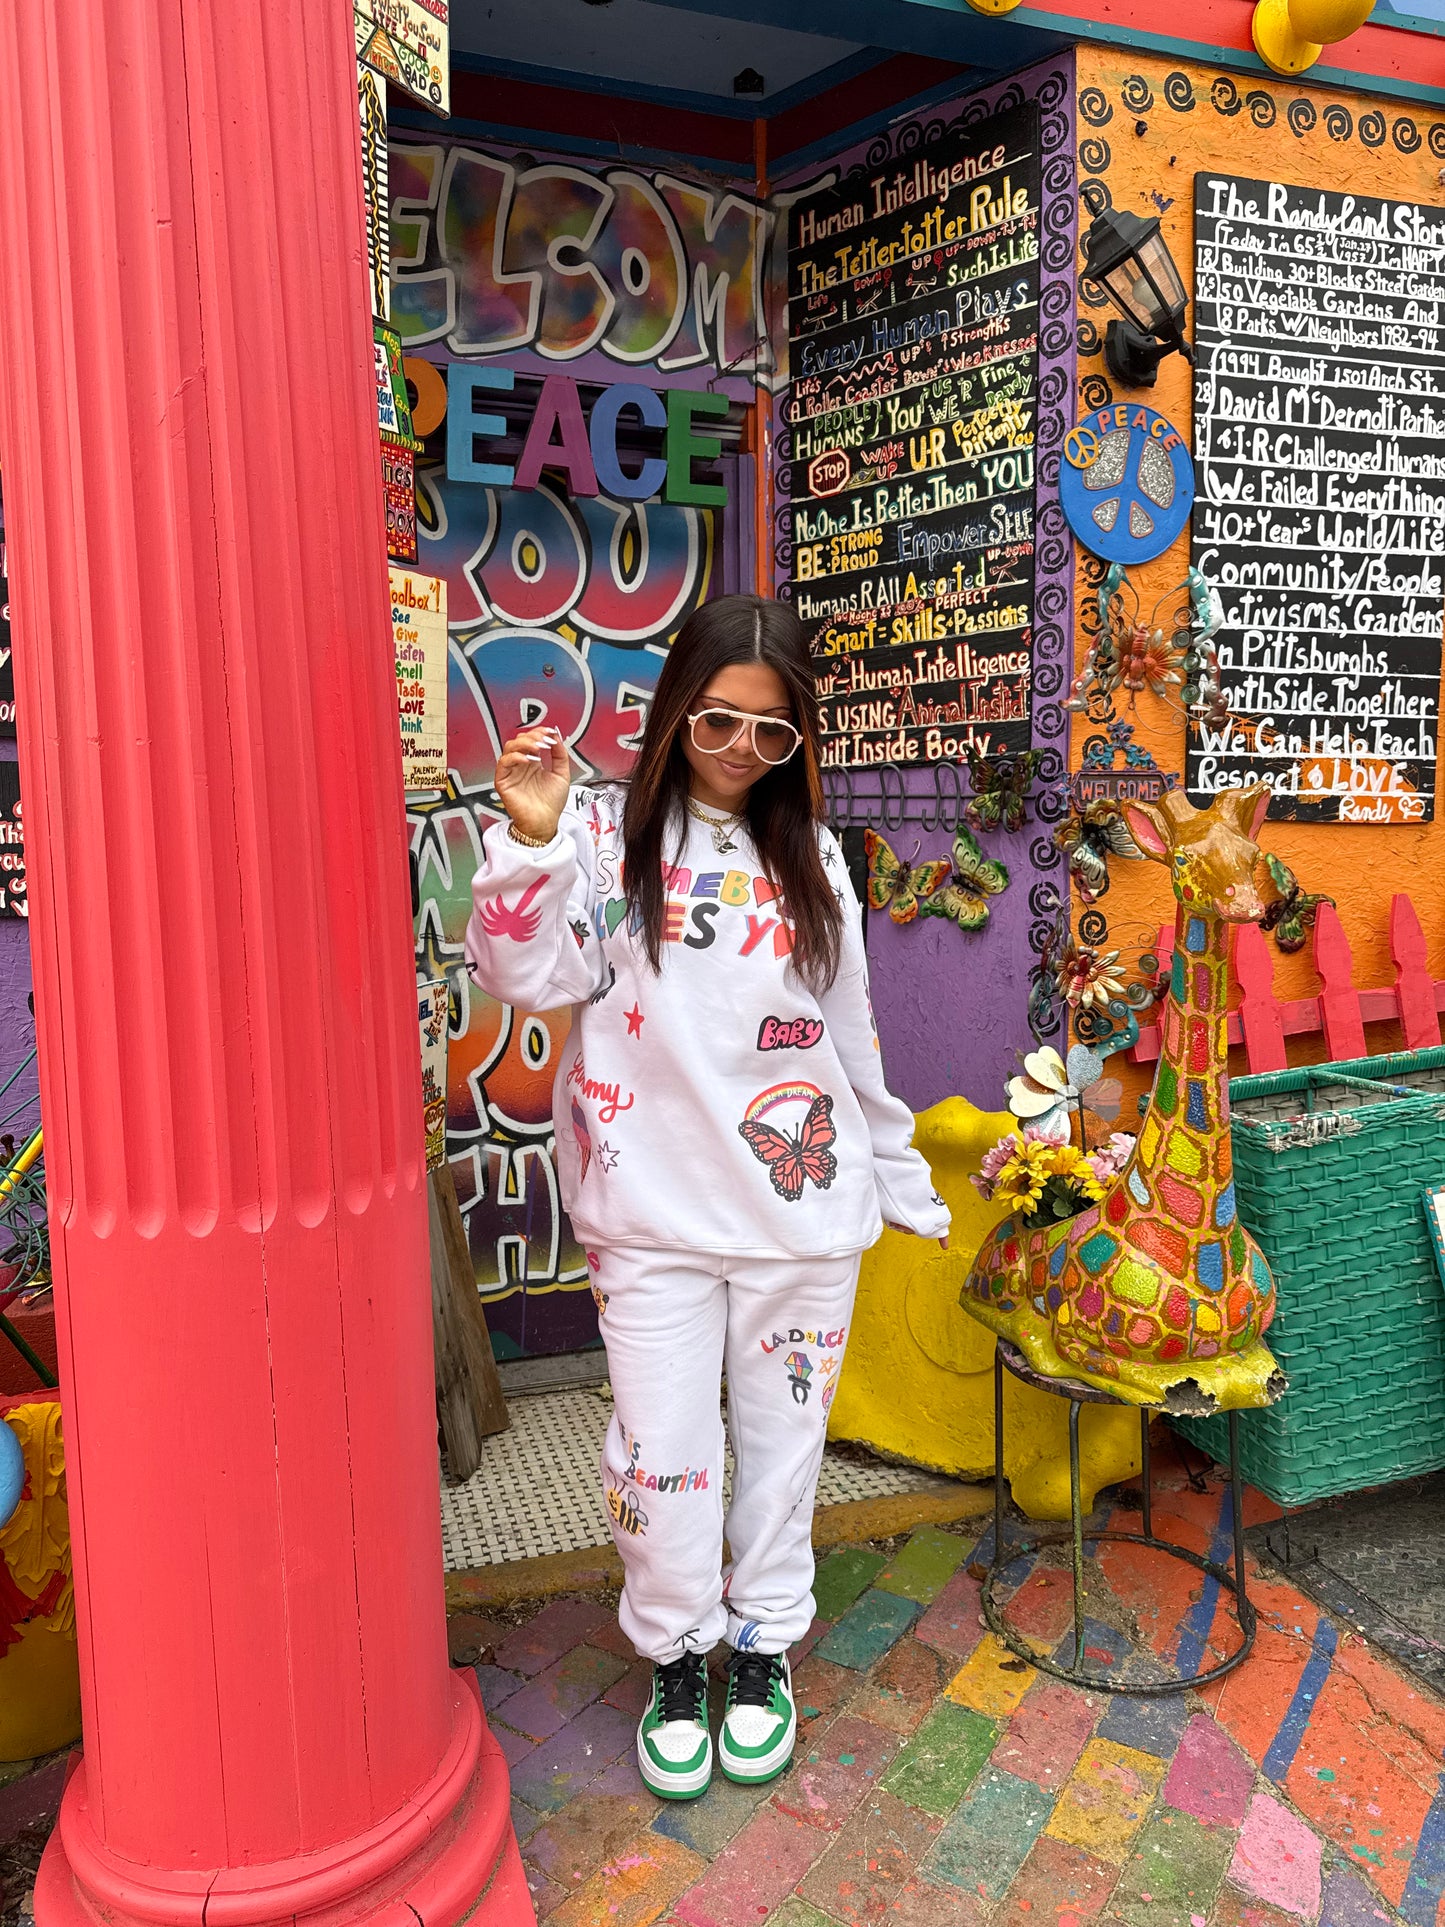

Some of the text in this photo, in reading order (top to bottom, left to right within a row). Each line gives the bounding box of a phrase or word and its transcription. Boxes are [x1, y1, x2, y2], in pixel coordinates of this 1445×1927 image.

[398, 45, 430, 78] GOOD
[405, 63, 427, 91] BAD
[800, 145, 1005, 248] Human Intelligence
[1207, 180, 1260, 221] The
[1268, 182, 1390, 246] Randyland
[797, 260, 838, 296] The
[970, 175, 1029, 232] Rule
[1220, 225, 1265, 252] Today
[911, 254, 931, 271] UP
[948, 231, 1039, 287] Such Is Life
[1221, 252, 1283, 288] Building
[1317, 263, 1364, 289] Blocks
[1365, 268, 1408, 295] Street
[853, 270, 882, 292] DOWN
[1221, 278, 1439, 325] 50 Vegetable Gardens And
[1221, 305, 1234, 330] 8
[1236, 307, 1277, 335] Parks
[801, 281, 1030, 377] Every Human Plays
[950, 314, 1011, 347] Strengths
[981, 363, 1017, 388] Fine
[986, 370, 1033, 408] Dandy
[1218, 351, 1440, 394] 1994 Bought 1501 Arch St.
[790, 401, 800, 421] A
[806, 392, 842, 416] Roller
[814, 401, 872, 437] PEOPLE
[1220, 385, 1281, 423] David
[1096, 404, 1182, 454] PEACE
[860, 440, 906, 466] WAKE
[876, 461, 898, 479] UP
[1385, 441, 1445, 477] Humans
[815, 461, 846, 483] STOP
[795, 452, 1036, 544] No One Is Better Then YOU
[1209, 467, 1445, 529] We Failed Everything
[797, 543, 826, 582] BE
[897, 521, 987, 572] Empower
[797, 592, 858, 621] Humans
[860, 580, 874, 610] R
[876, 575, 901, 609] All
[904, 555, 987, 602] Assorted
[396, 626, 418, 643] Give
[824, 617, 877, 657] Smart
[890, 606, 948, 646] Skills
[954, 599, 1030, 635] Passions
[1354, 597, 1444, 635] Gardens
[395, 662, 423, 680] Smell
[912, 643, 1031, 687] Intelligence
[1243, 629, 1389, 690] Pittsburghs
[397, 679, 425, 698] Taste
[1332, 677, 1435, 731] Together
[398, 700, 425, 716] LOVE
[836, 700, 897, 732] USING
[897, 684, 965, 728] Animal
[851, 728, 920, 765] Inside
[926, 723, 992, 762] Body
[1200, 717, 1435, 770] We Can Help Teach
[1079, 779, 1161, 801] WELCOME
[1332, 758, 1408, 794] LOVE
[1338, 796, 1394, 824] Randy
[759, 1018, 823, 1050] BABY
[787, 1087, 814, 1101] DREAM
[760, 1332, 787, 1354] LA
